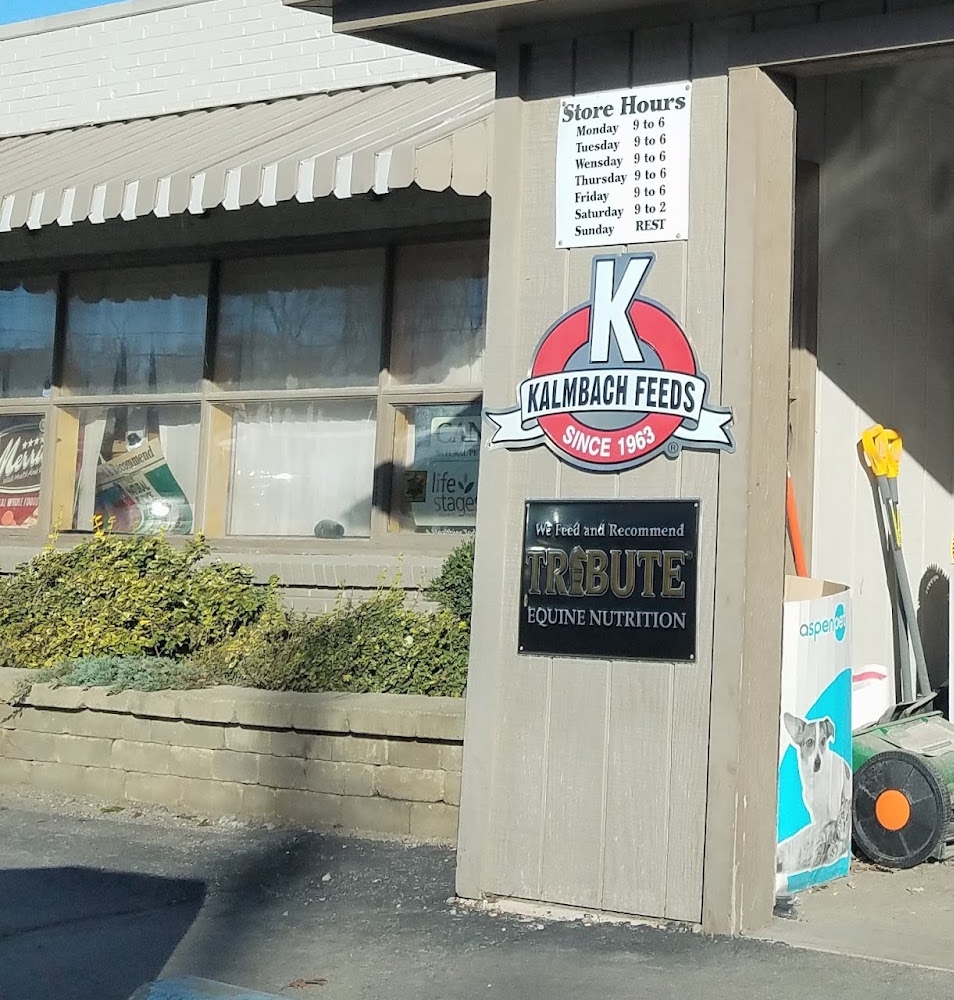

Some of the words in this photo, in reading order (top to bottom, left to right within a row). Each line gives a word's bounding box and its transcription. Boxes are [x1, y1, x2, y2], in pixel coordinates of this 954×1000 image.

[562, 103, 614, 123] Store
[620, 95, 686, 116] Hours
[576, 123, 619, 137] Monday
[633, 119, 640, 130] 9
[643, 119, 655, 129] to
[658, 117, 665, 128] 6
[576, 140, 620, 153] Tuesday
[634, 136, 641, 147] 9
[644, 135, 656, 146] to
[659, 134, 666, 144] 6
[575, 156, 624, 169] Wensday
[634, 153, 640, 164] 9
[644, 152, 655, 163] to
[659, 151, 666, 161] 6
[575, 173, 627, 186] Thursday
[634, 170, 641, 180] 9
[645, 169, 656, 180] to
[660, 167, 666, 178] 6
[575, 190, 609, 203] Friday
[634, 187, 640, 198] 9
[644, 186, 655, 196] to
[659, 185, 666, 195] 6
[575, 206, 624, 220] Saturday
[634, 204, 641, 215] 9
[645, 203, 656, 213] to
[660, 201, 666, 212] 2
[575, 224, 614, 237] Sunday
[635, 219, 666, 231] REST
[590, 257, 652, 363] K
[527, 375, 628, 413] KALMBACH
[635, 376, 696, 413] FEEDS
[562, 425, 611, 457] SINCE
[618, 425, 656, 456] 1963
[432, 471, 456, 493] life
[434, 495, 477, 517] stage
[536, 522, 551, 536] We
[555, 522, 580, 536] Feed
[584, 523, 605, 537] and
[608, 523, 685, 537] Recommend
[525, 545, 686, 599] TRIBUTE
[527, 606, 586, 627] EQUINE
[590, 610, 687, 629] NUTRITION
